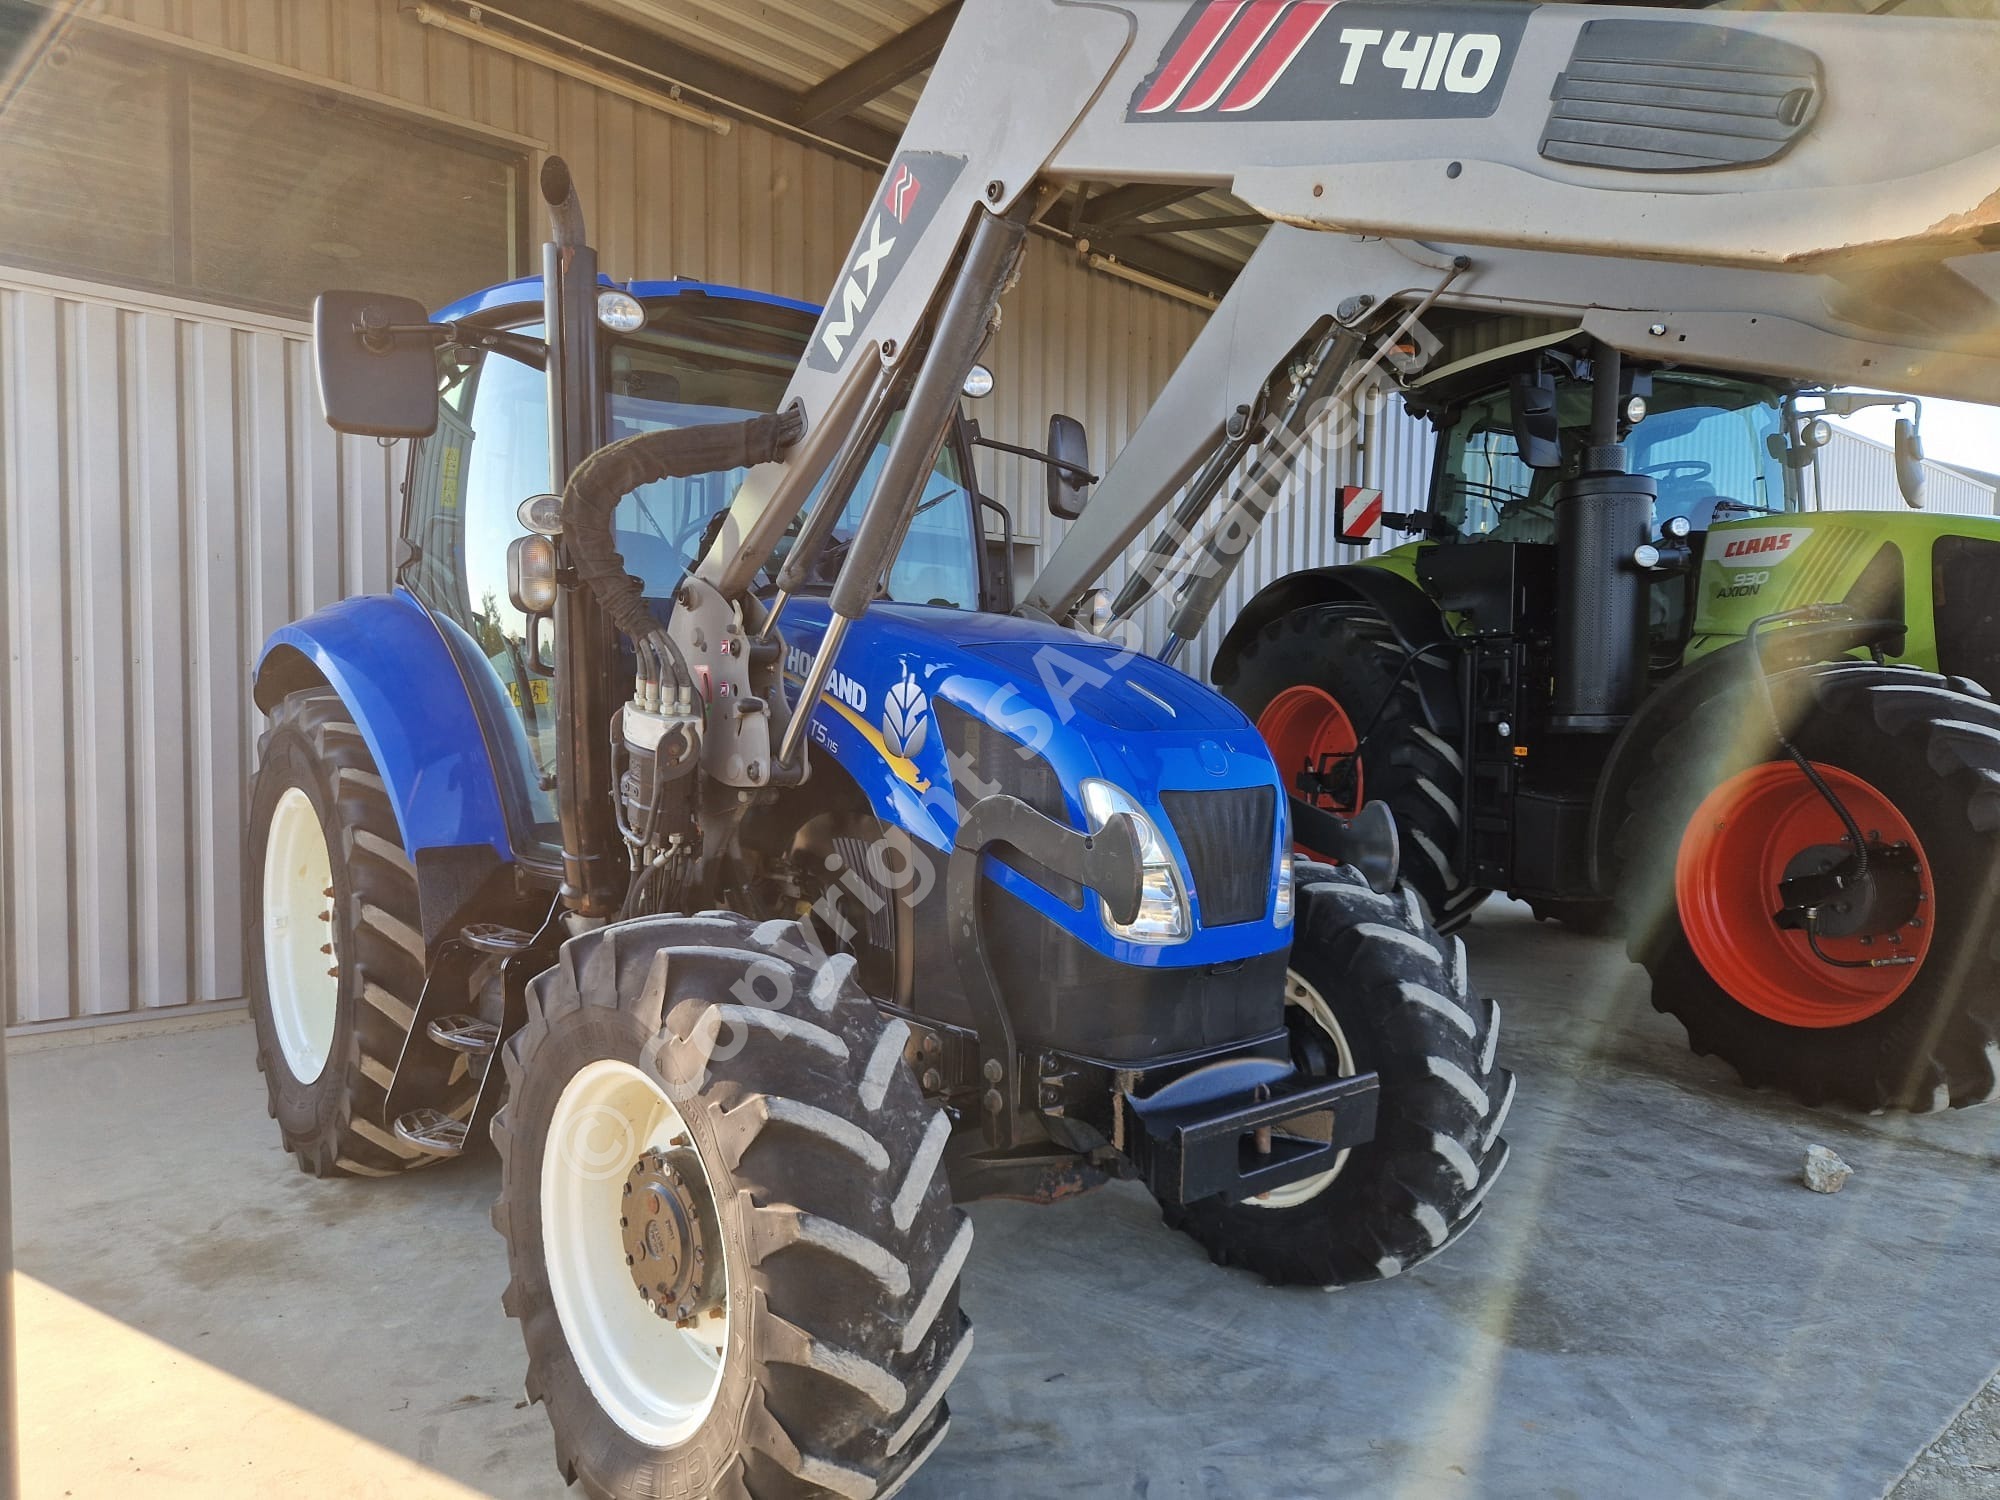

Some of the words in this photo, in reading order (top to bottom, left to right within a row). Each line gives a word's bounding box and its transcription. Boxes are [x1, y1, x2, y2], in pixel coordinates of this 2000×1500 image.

[1339, 28, 1501, 94] T410
[822, 212, 897, 363] MX
[1725, 533, 1792, 557] CLAAS
[1717, 584, 1762, 598] AXION
[1733, 571, 1770, 586] 930
[787, 645, 867, 713] HOAND
